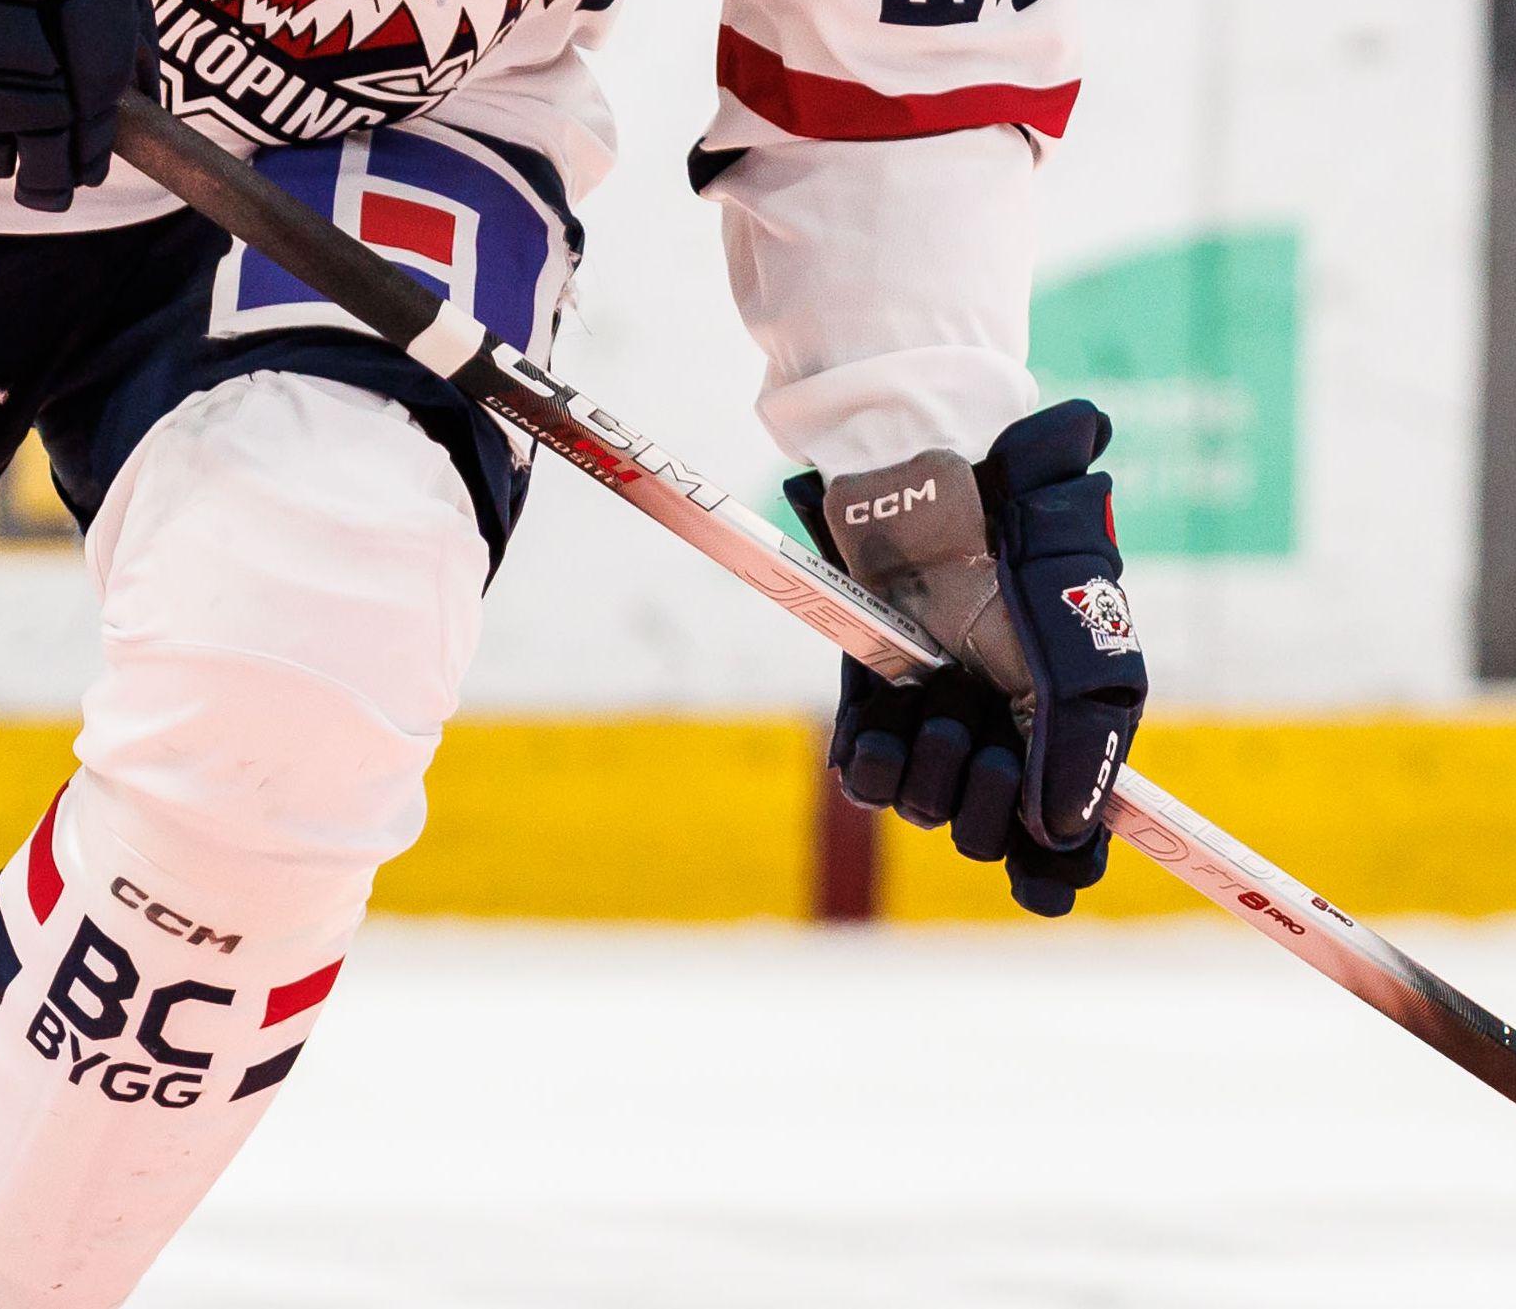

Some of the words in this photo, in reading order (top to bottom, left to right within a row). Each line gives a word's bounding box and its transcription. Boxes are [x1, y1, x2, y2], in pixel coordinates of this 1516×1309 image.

[490, 341, 731, 513] CCM
[845, 478, 937, 525] CCM
[109, 875, 243, 955] CCM
[1263, 906, 1306, 936] PRO
[46, 912, 238, 1071] BC
[25, 1001, 204, 1109] BYGG
